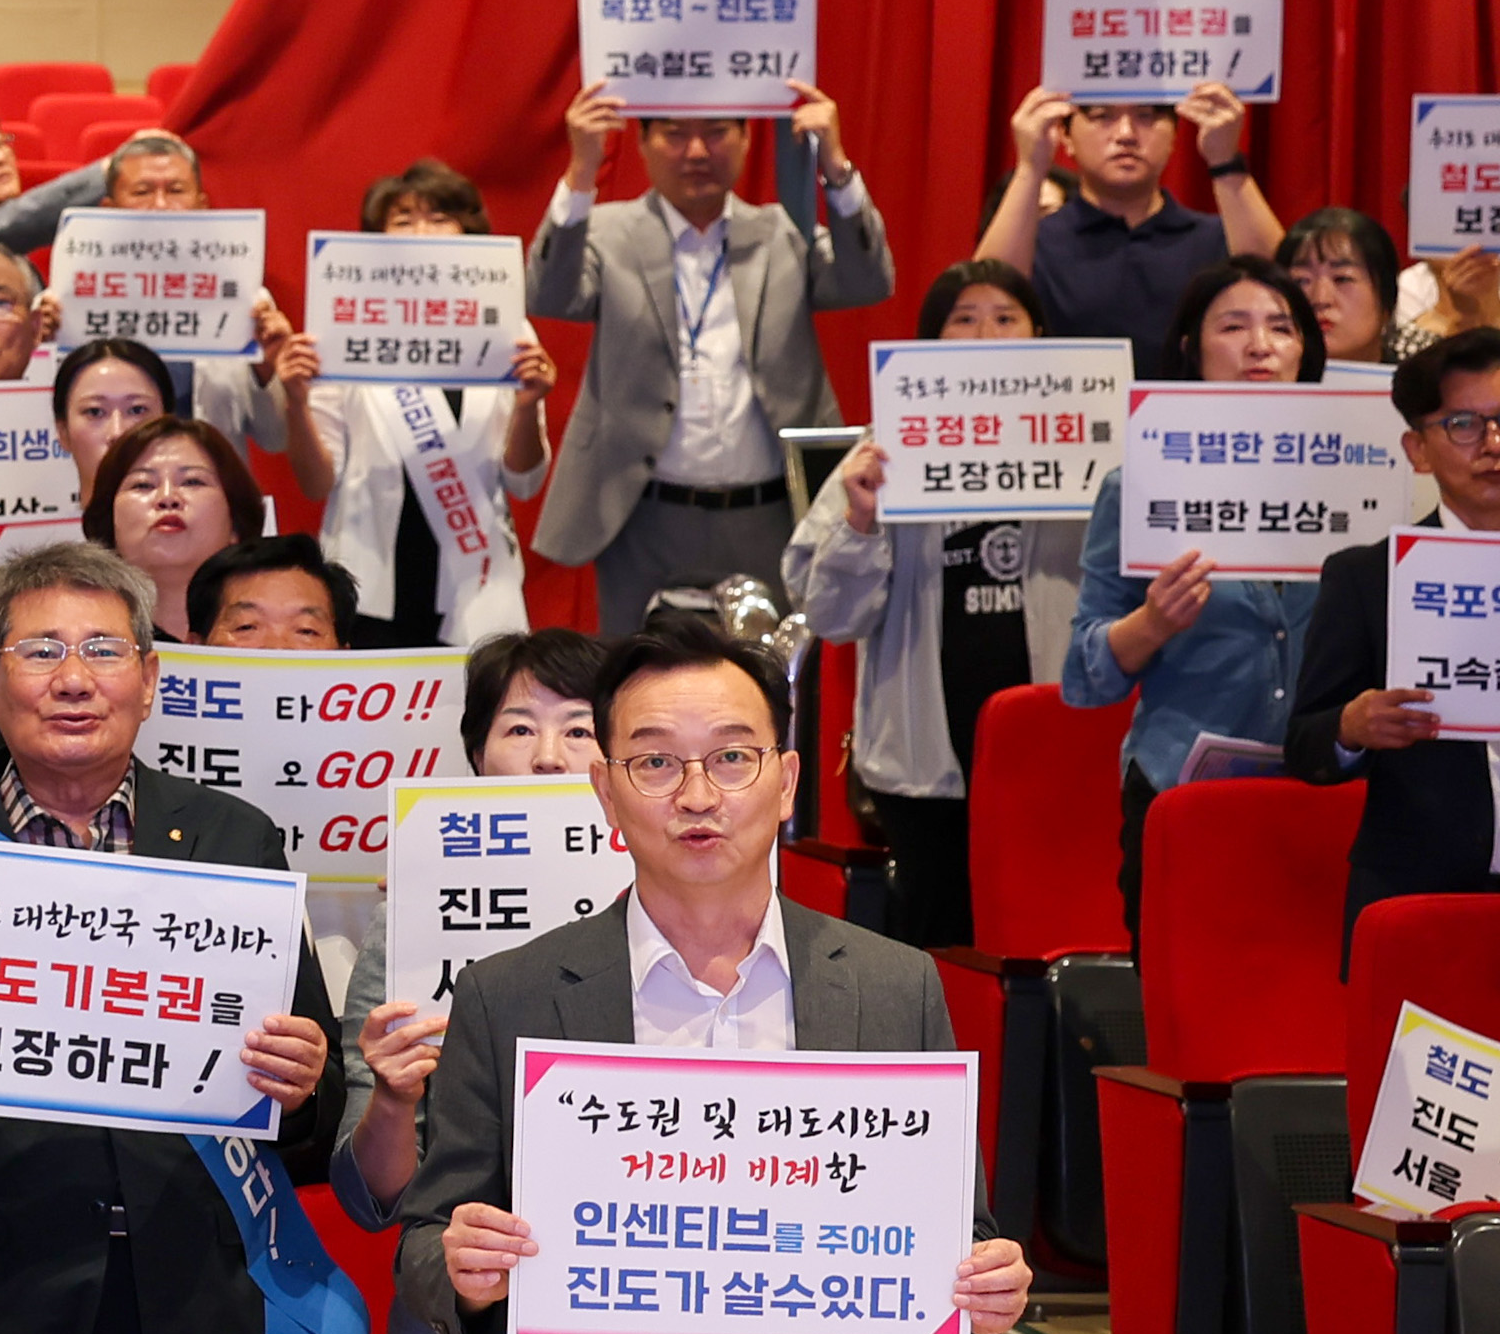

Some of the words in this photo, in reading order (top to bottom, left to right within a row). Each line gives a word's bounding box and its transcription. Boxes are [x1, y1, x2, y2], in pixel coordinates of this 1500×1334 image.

[1083, 49, 1209, 79] 보장하라
[85, 310, 199, 341] 보장하라
[344, 337, 463, 367] 보장하라
[899, 414, 1003, 447] 공정한
[1020, 413, 1111, 444] 기회를
[1142, 430, 1264, 464] “특별한
[924, 460, 1063, 492] 보장하라
[1146, 500, 1249, 532] 특별한
[1258, 501, 1349, 533] 보상을
[159, 675, 243, 720] 철도
[439, 813, 530, 857] 철도
[13, 901, 140, 945] 대한민국
[153, 913, 276, 959] 국민이다.
[439, 888, 530, 931] 진도
[1425, 1045, 1492, 1099] 철도
[559, 1091, 679, 1137] “수도권
[704, 1098, 735, 1140] 및
[758, 1106, 929, 1138] 대도시와의
[1410, 1097, 1480, 1153] 진도
[621, 1151, 726, 1183] 거리에
[749, 1152, 866, 1193] 비례한
[1392, 1147, 1462, 1201] 서울
[574, 1202, 804, 1253] 인센티브를
[817, 1225, 915, 1256] 주어야
[567, 1267, 709, 1314] 진도가
[722, 1272, 925, 1320] 살수있다.
